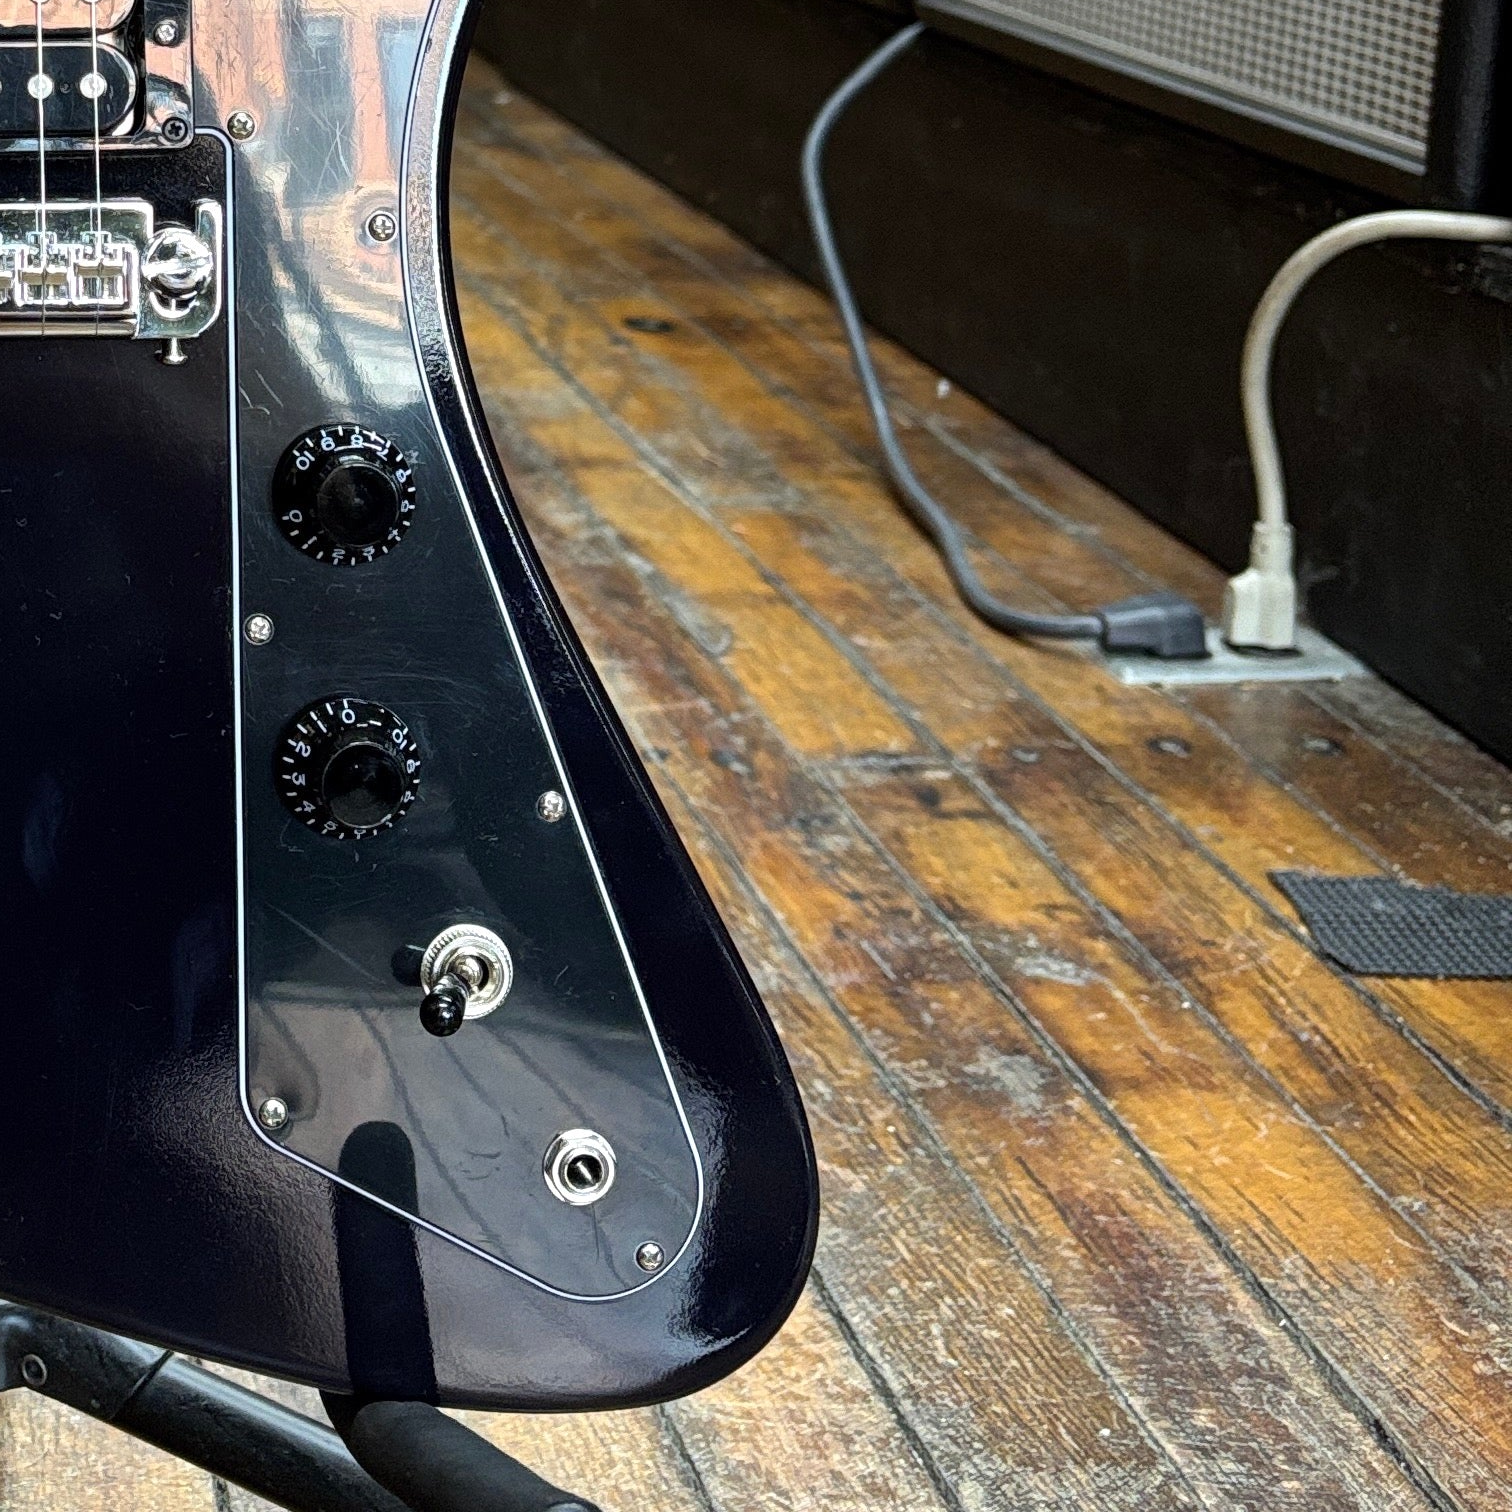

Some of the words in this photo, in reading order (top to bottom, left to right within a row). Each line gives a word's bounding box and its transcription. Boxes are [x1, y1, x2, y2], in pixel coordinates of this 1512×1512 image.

[341, 708, 356, 725] 0
[294, 740, 312, 758] 2
[291, 771, 307, 787] 3
